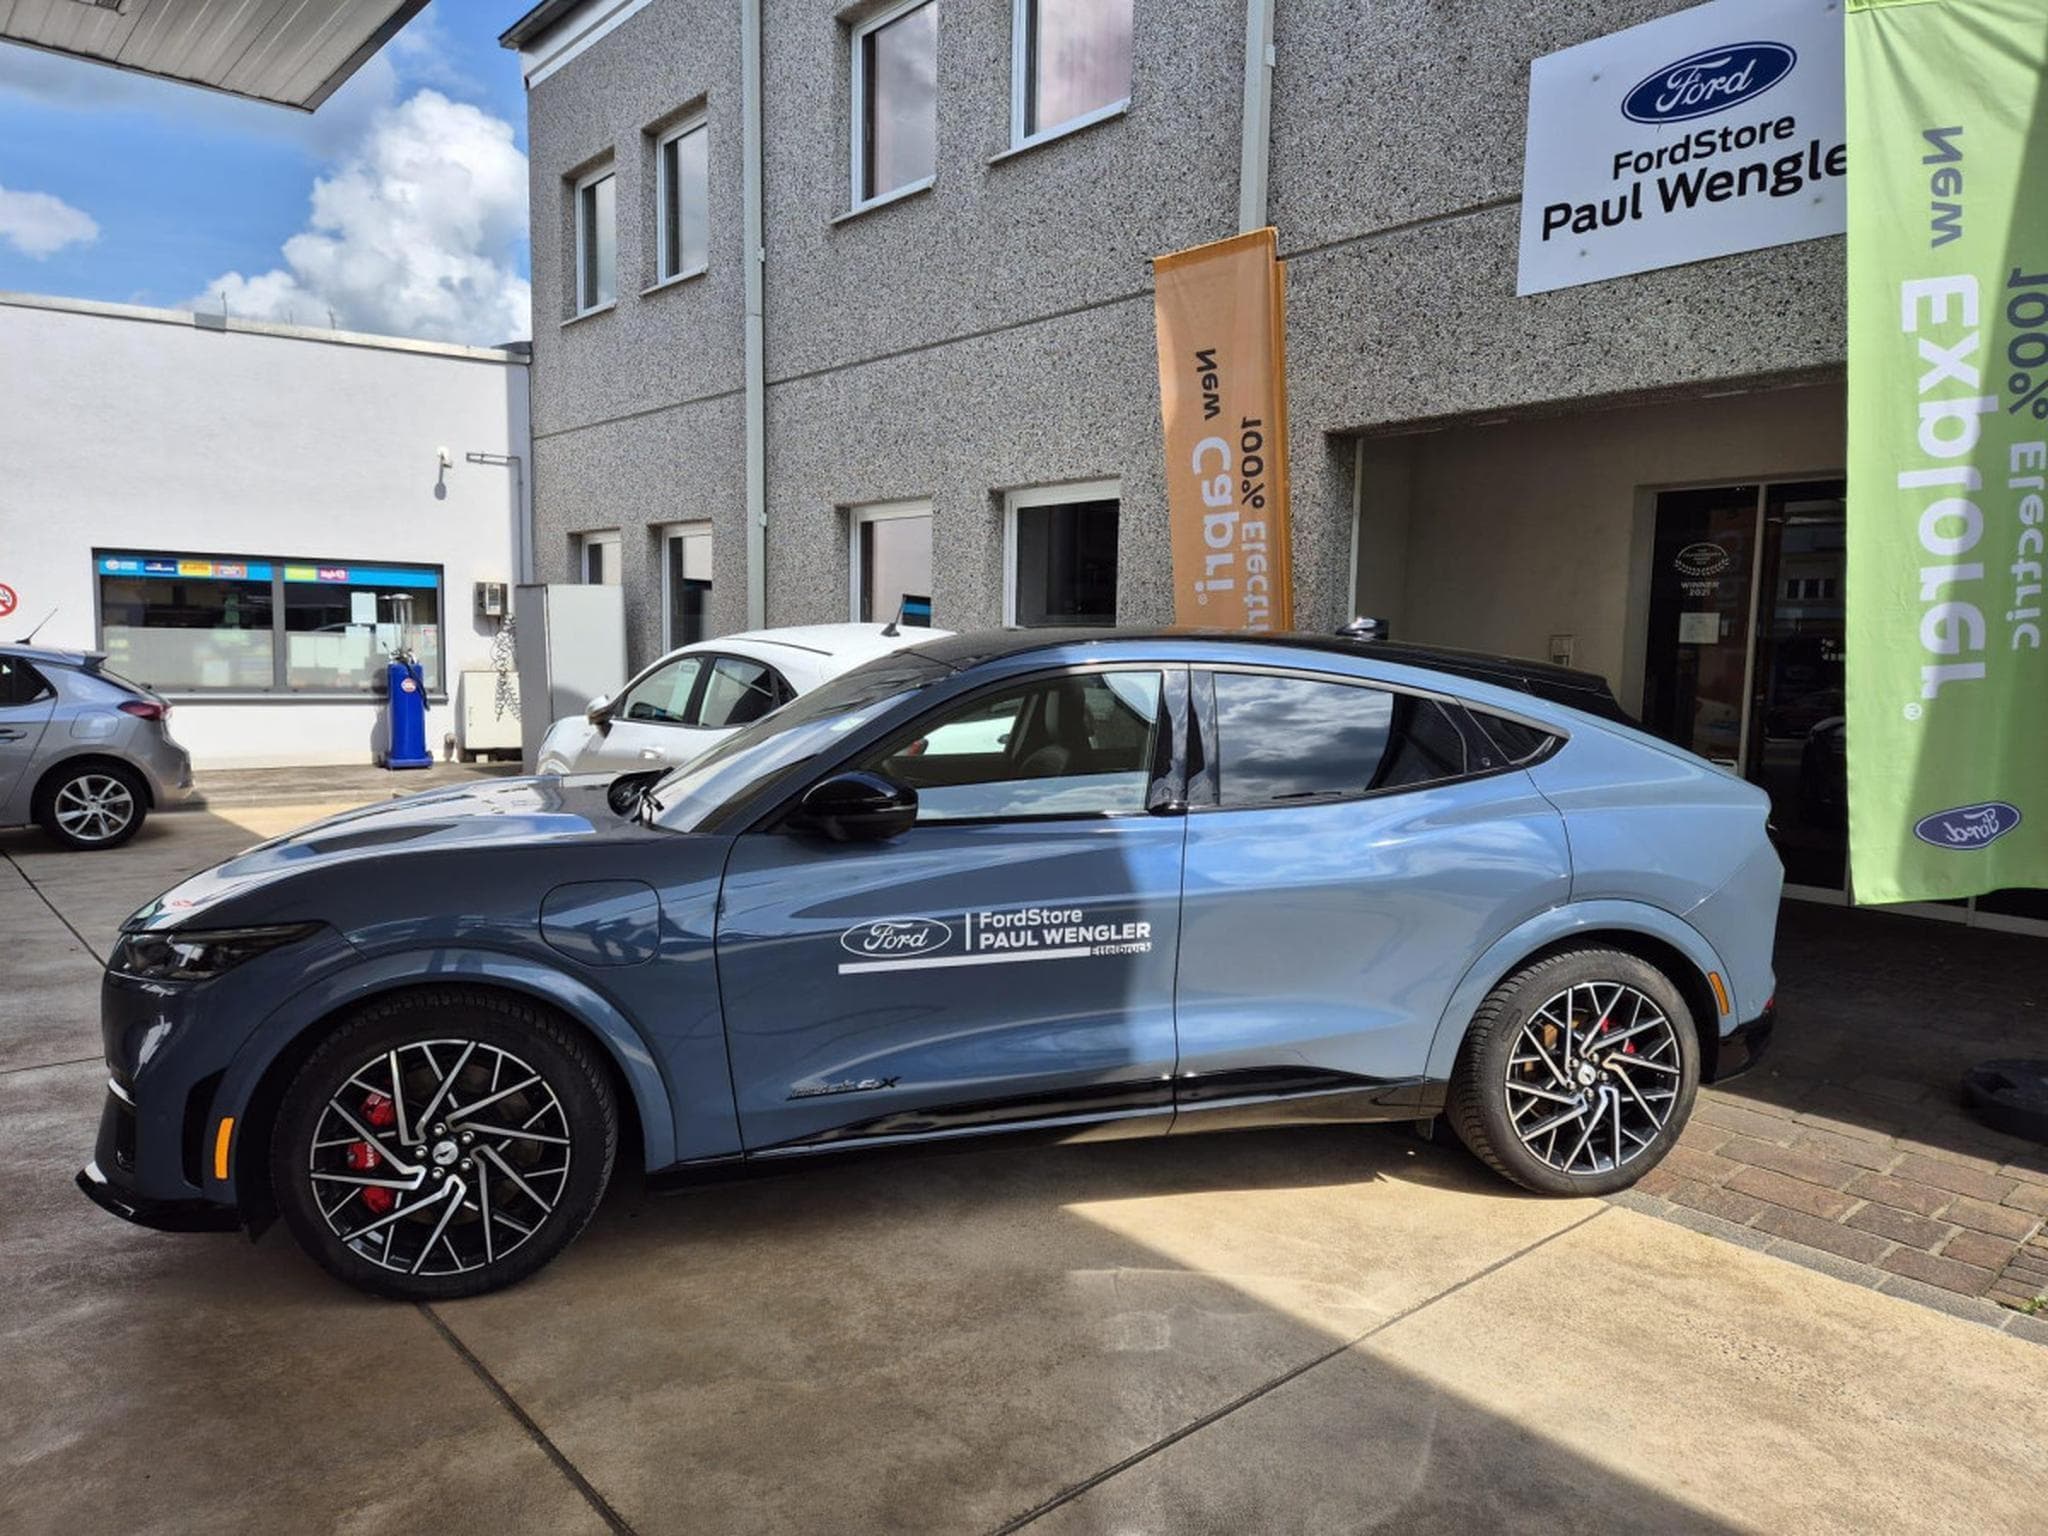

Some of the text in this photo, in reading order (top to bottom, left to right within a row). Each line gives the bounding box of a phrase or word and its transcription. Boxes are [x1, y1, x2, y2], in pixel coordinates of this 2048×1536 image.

[1613, 116, 1796, 180] FordStore
[1542, 141, 1847, 241] Paul Wengle
[979, 908, 1083, 928] FordStore
[979, 922, 1151, 950] PAUL WENGLER
